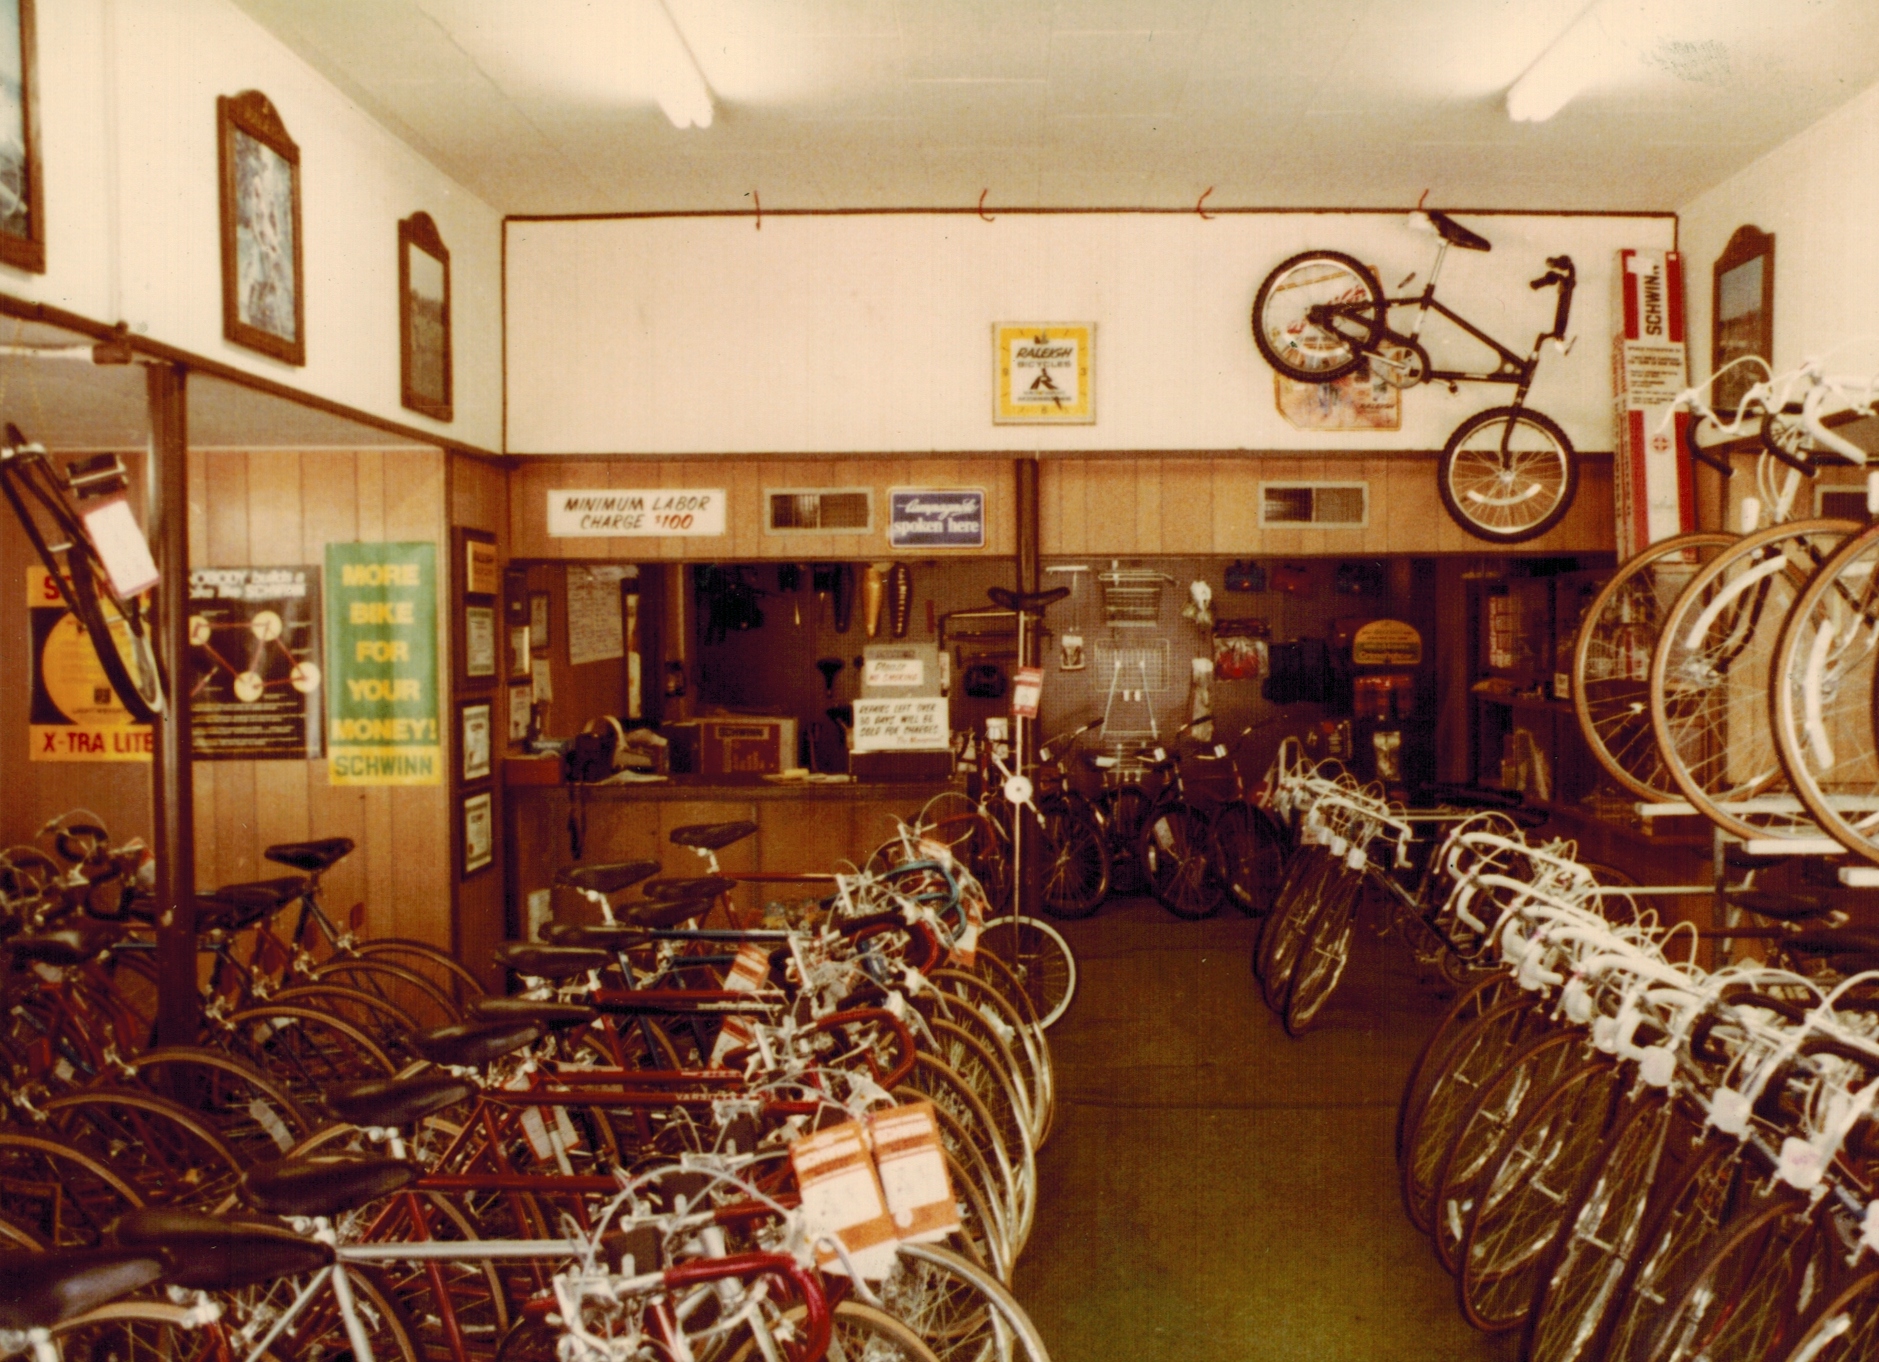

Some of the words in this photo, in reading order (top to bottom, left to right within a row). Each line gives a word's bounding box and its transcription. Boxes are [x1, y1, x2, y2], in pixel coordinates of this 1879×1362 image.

[1015, 347, 1073, 358] RALEIGH
[564, 497, 644, 512] MINIMUM
[652, 495, 710, 511] LABOR
[580, 514, 645, 530] CHARGE
[893, 517, 943, 537] spoken
[947, 517, 979, 533] here
[342, 564, 420, 587] MORE
[350, 602, 414, 624] BIKE
[356, 640, 409, 663] FOR
[346, 679, 420, 701] YOUR
[894, 704, 912, 713] LEFT
[915, 703, 937, 712] OVER
[331, 718, 436, 741] MONEY!
[874, 716, 895, 725] DAYS
[901, 715, 919, 723] WILL
[923, 714, 934, 723] BE
[860, 727, 881, 737] SOLD
[884, 726, 899, 735] FOR
[903, 725, 939, 735] CHARGES
[43, 732, 106, 753] X-TRA
[113, 732, 153, 753] LITE
[335, 755, 433, 776] SCHWINN
